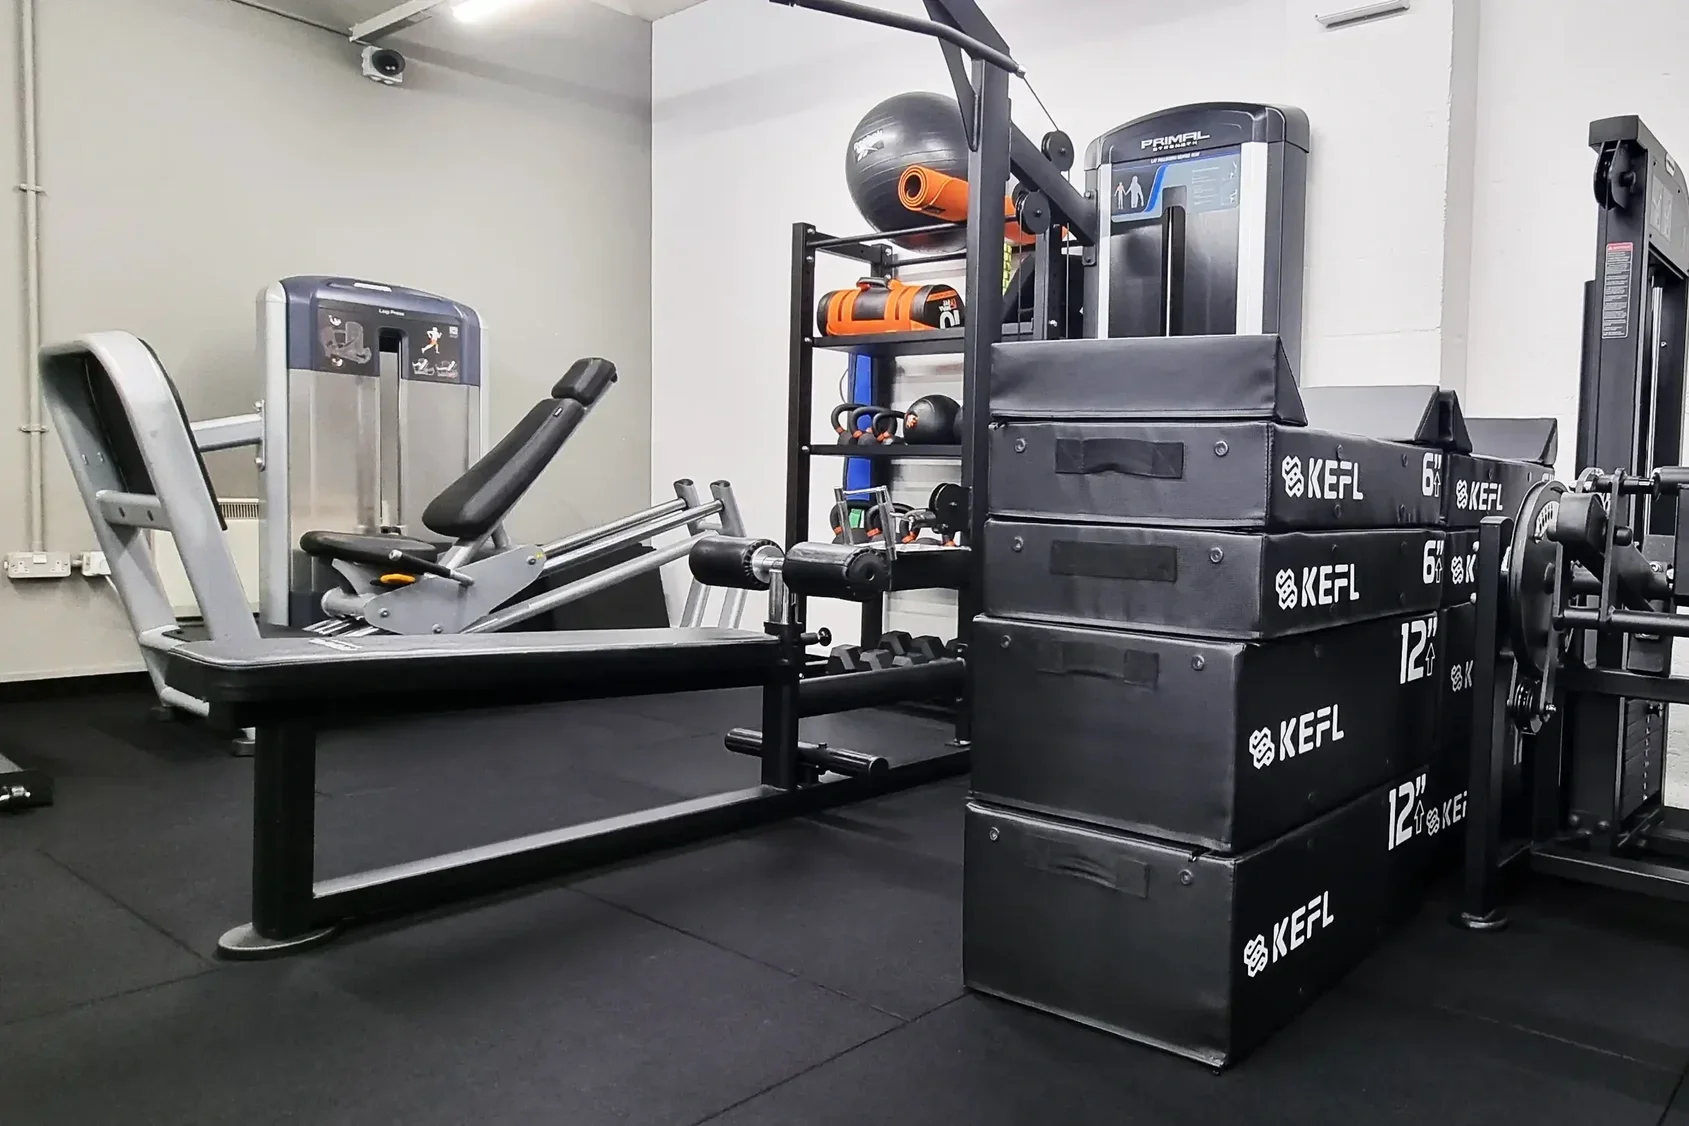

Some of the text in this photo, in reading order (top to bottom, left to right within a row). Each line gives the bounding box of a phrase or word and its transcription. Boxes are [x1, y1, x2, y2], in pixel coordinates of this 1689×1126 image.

[1141, 131, 1210, 149] PRIMAL
[1306, 457, 1364, 500] KEFL
[1466, 480, 1504, 511] KEFL
[1301, 563, 1360, 608] KEFL
[1279, 703, 1345, 762] KEFL
[1442, 790, 1468, 829] KE
[1272, 890, 1335, 964] KEFL
